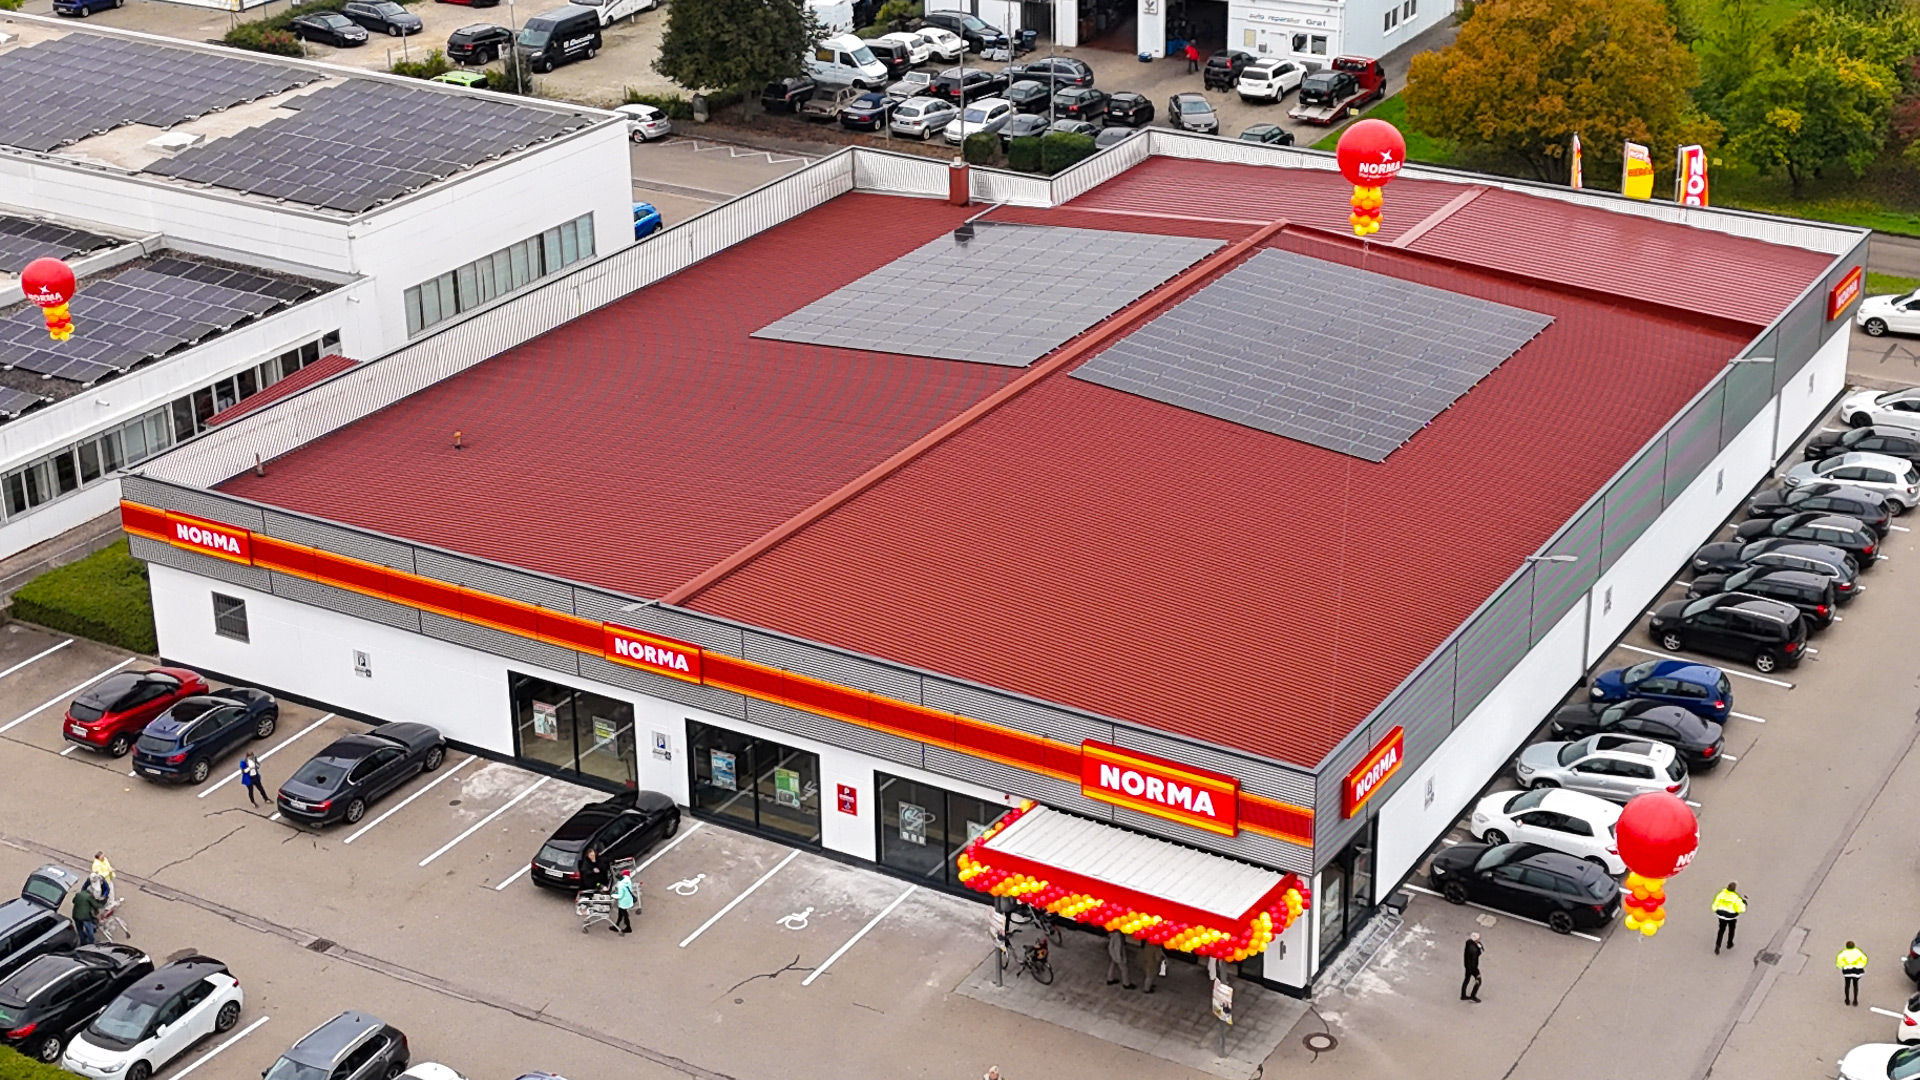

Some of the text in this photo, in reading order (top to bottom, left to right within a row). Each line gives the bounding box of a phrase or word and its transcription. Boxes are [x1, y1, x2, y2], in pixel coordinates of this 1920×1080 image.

[1359, 161, 1401, 175] NORMA
[1836, 279, 1858, 310] NORMA
[176, 523, 241, 554] NORMA
[614, 637, 690, 672] NORMA
[1100, 764, 1216, 817] NORMA
[1355, 747, 1397, 801] NORMA
